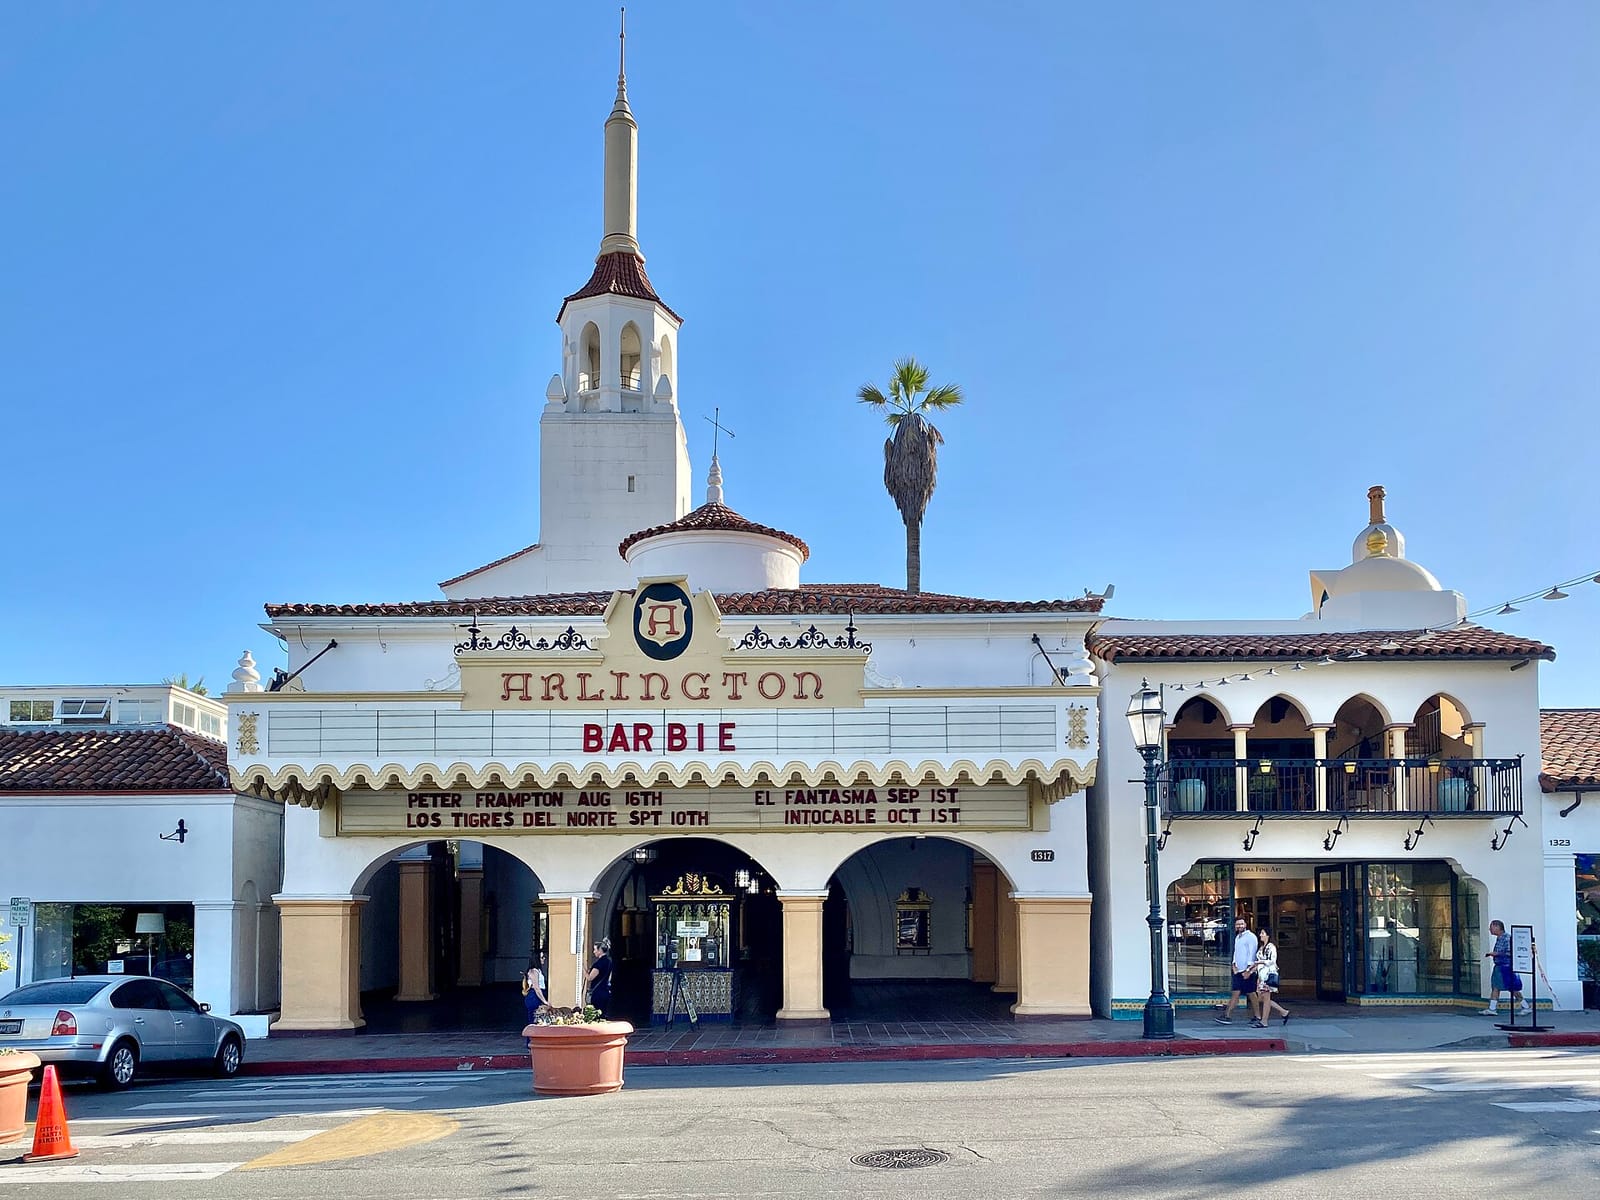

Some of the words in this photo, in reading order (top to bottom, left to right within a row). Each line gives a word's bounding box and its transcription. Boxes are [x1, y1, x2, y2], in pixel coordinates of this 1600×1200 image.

[647, 605, 680, 635] A
[501, 669, 824, 701] ARLINGTON
[582, 722, 737, 753] BARBIE
[408, 792, 462, 808] PETER
[475, 791, 564, 808] FRAMPTON
[577, 791, 611, 807] AUG
[625, 791, 663, 807] 16TH
[755, 790, 776, 806] EL
[785, 788, 878, 805] FANTASMA
[887, 788, 920, 803] SEP
[406, 812, 442, 828] LOS
[451, 811, 515, 828] TIGRES
[522, 811, 557, 827] DEL
[566, 811, 617, 827] NORTE
[629, 810, 662, 826] SPT
[784, 808, 876, 825] INTOCABLE
[887, 808, 921, 823] OCT
[1549, 839, 1571, 847] 1323
[1034, 851, 1052, 860] 1317
